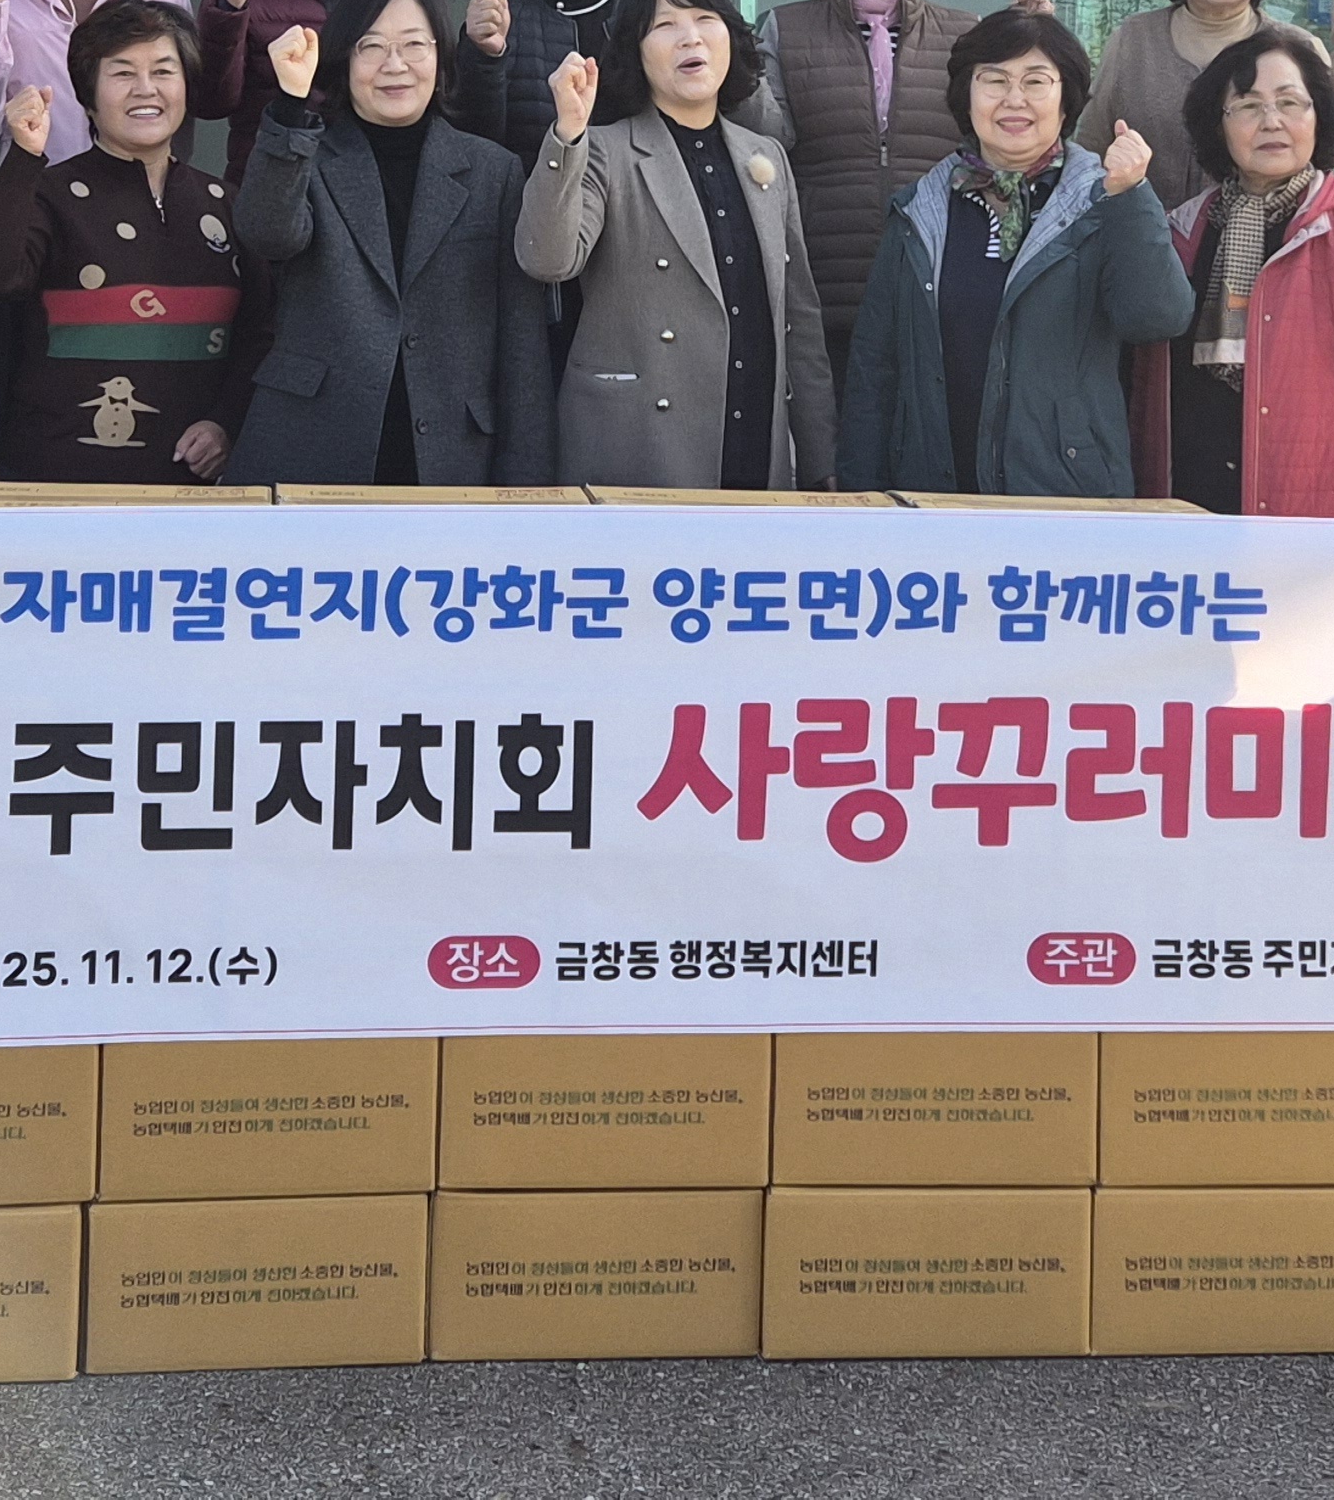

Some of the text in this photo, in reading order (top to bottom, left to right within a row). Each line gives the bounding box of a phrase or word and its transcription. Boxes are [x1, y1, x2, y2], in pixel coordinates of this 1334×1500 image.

[130, 289, 166, 318] G
[0, 566, 1266, 643] 자매결연지(강화군 양도면)와 함께하는
[10, 713, 593, 856] 주민자치회
[637, 697, 1331, 863] 사랑꾸러미
[445, 939, 878, 981] 장소 금창동 행정복지센터
[1043, 937, 1117, 978] 주관
[1153, 940, 1252, 979] 금창동
